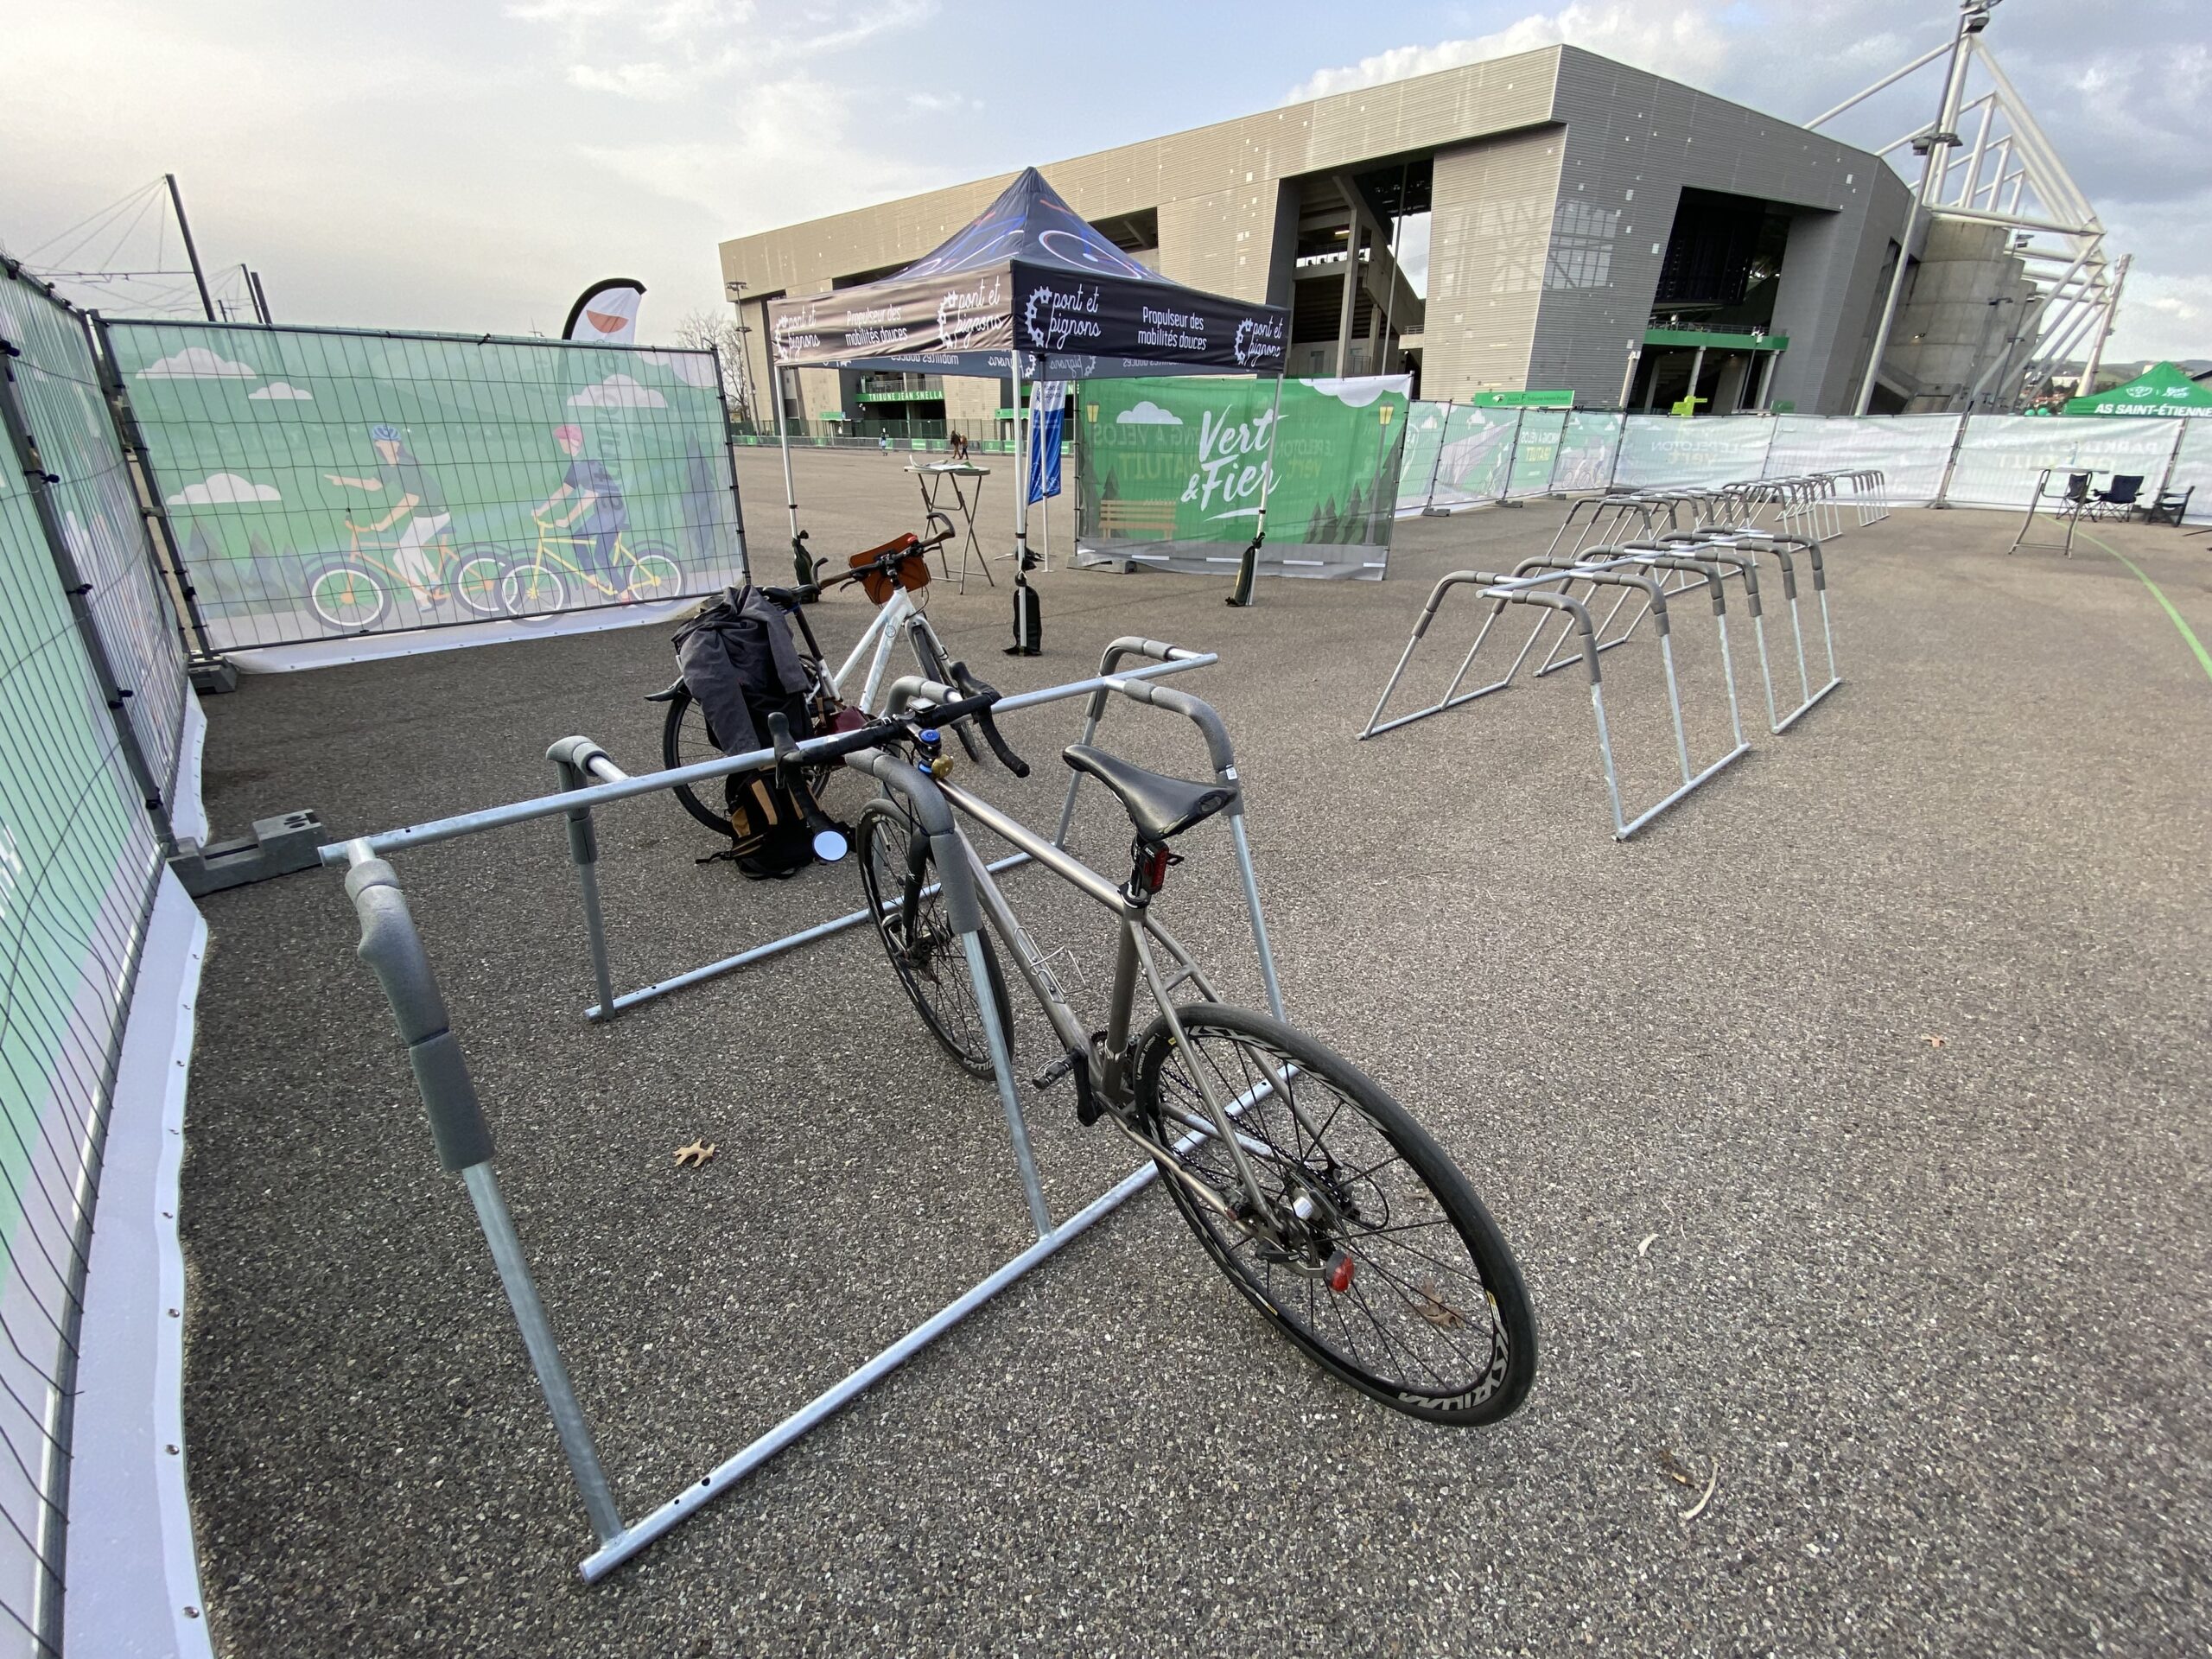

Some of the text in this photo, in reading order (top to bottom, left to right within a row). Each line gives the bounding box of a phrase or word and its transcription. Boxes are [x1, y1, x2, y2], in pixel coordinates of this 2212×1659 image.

[958, 276, 1001, 311] pont et
[1053, 283, 1100, 314] pont et
[808, 304, 817, 327] et
[847, 304, 901, 328] Propulseur des
[1142, 306, 1205, 330] Propulseur des
[1253, 315, 1283, 339] pont et
[845, 327, 908, 346] mobilités douces
[954, 312, 1003, 349] pignons
[1046, 313, 1102, 350] pignons
[1138, 328, 1207, 351] mobilités douces
[869, 391, 944, 402] TRIBUNE JEAN SNELLA
[2094, 404, 2113, 414] AS
[1199, 404, 1289, 462] Vert
[1180, 454, 1282, 512] & Fier
